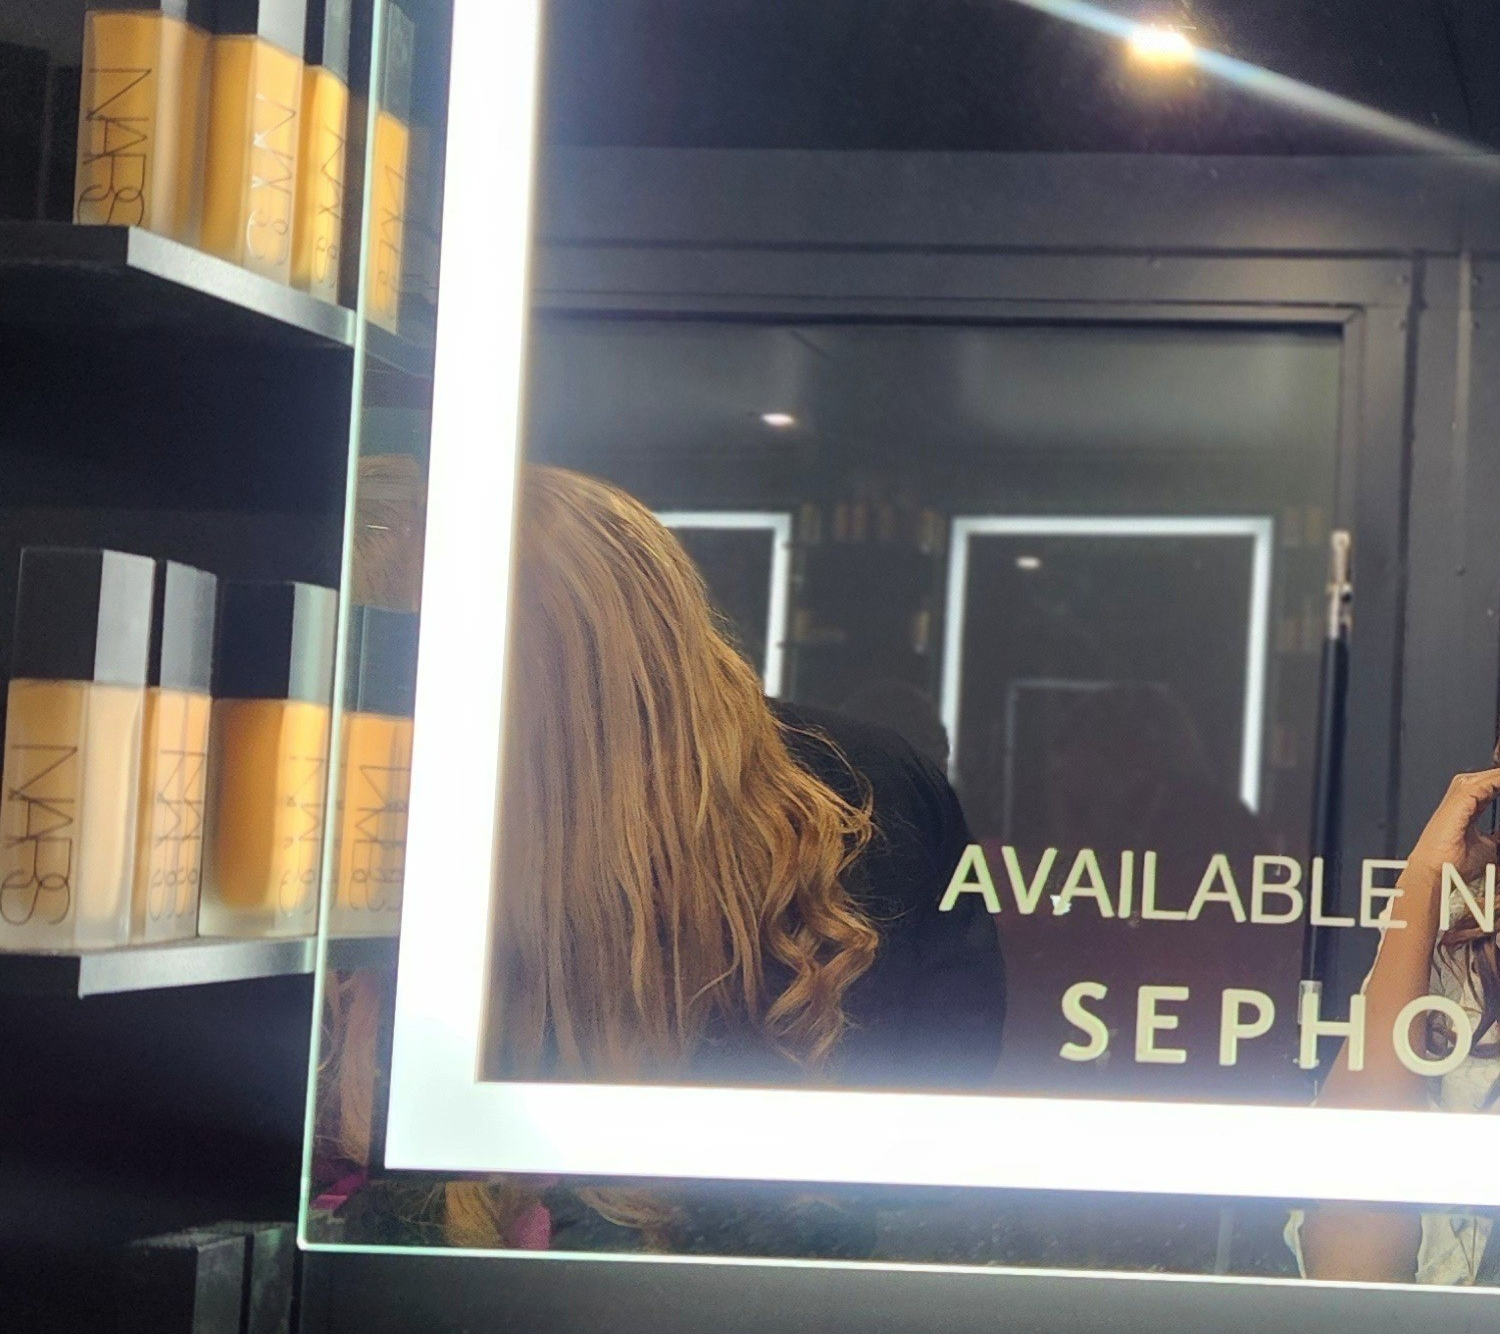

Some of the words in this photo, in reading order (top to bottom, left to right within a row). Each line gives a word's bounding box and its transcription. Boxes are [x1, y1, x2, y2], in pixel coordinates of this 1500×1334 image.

[83, 68, 152, 224] NARS
[0, 744, 78, 926] NARS
[938, 844, 1408, 930] AVAILABLE
